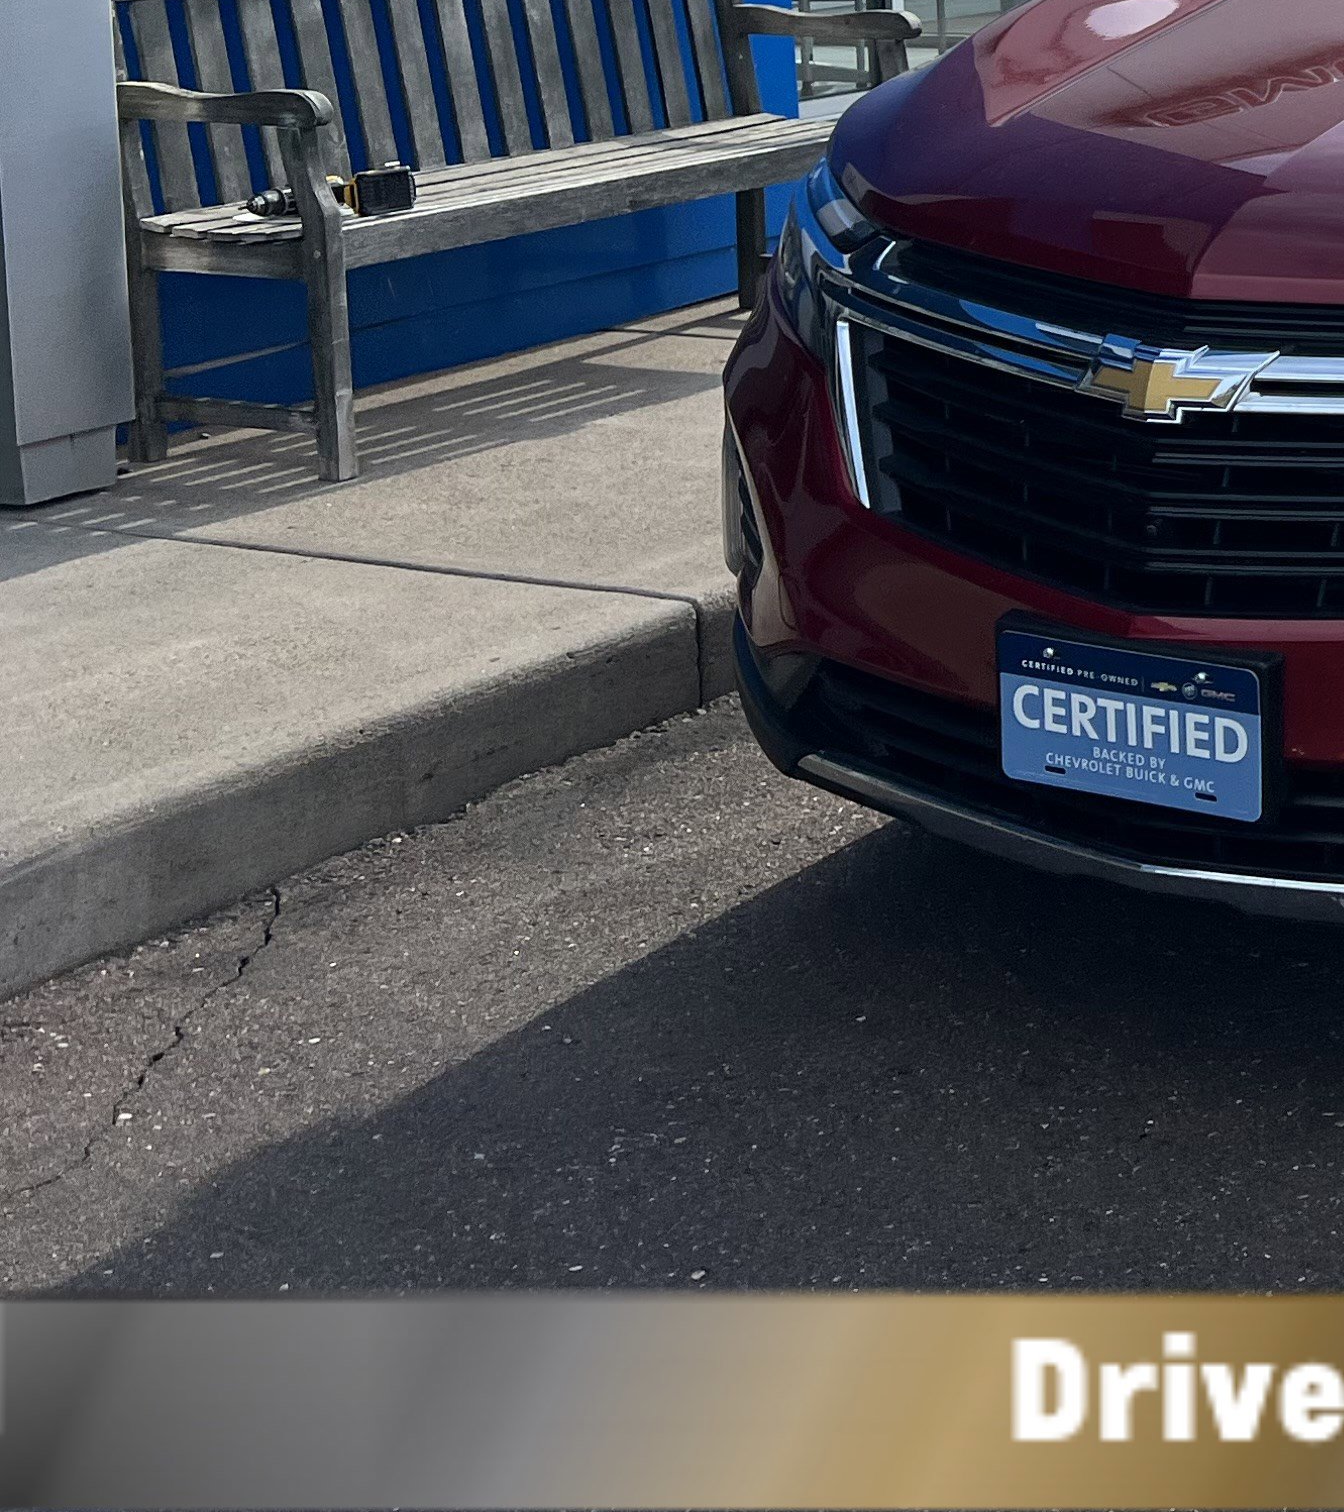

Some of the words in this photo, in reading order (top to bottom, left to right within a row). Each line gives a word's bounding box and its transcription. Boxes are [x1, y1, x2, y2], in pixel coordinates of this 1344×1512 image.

[1021, 659, 1074, 676] CERTIFIED
[1012, 684, 1249, 764] CERTIFIED
[1045, 752, 1121, 776] CHEVROLET
[1125, 766, 1166, 784] BUICK
[1169, 774, 1180, 787] &
[1183, 776, 1216, 793] GMC
[1092, 746, 1145, 767] BACKED
[1149, 756, 1166, 770] BY
